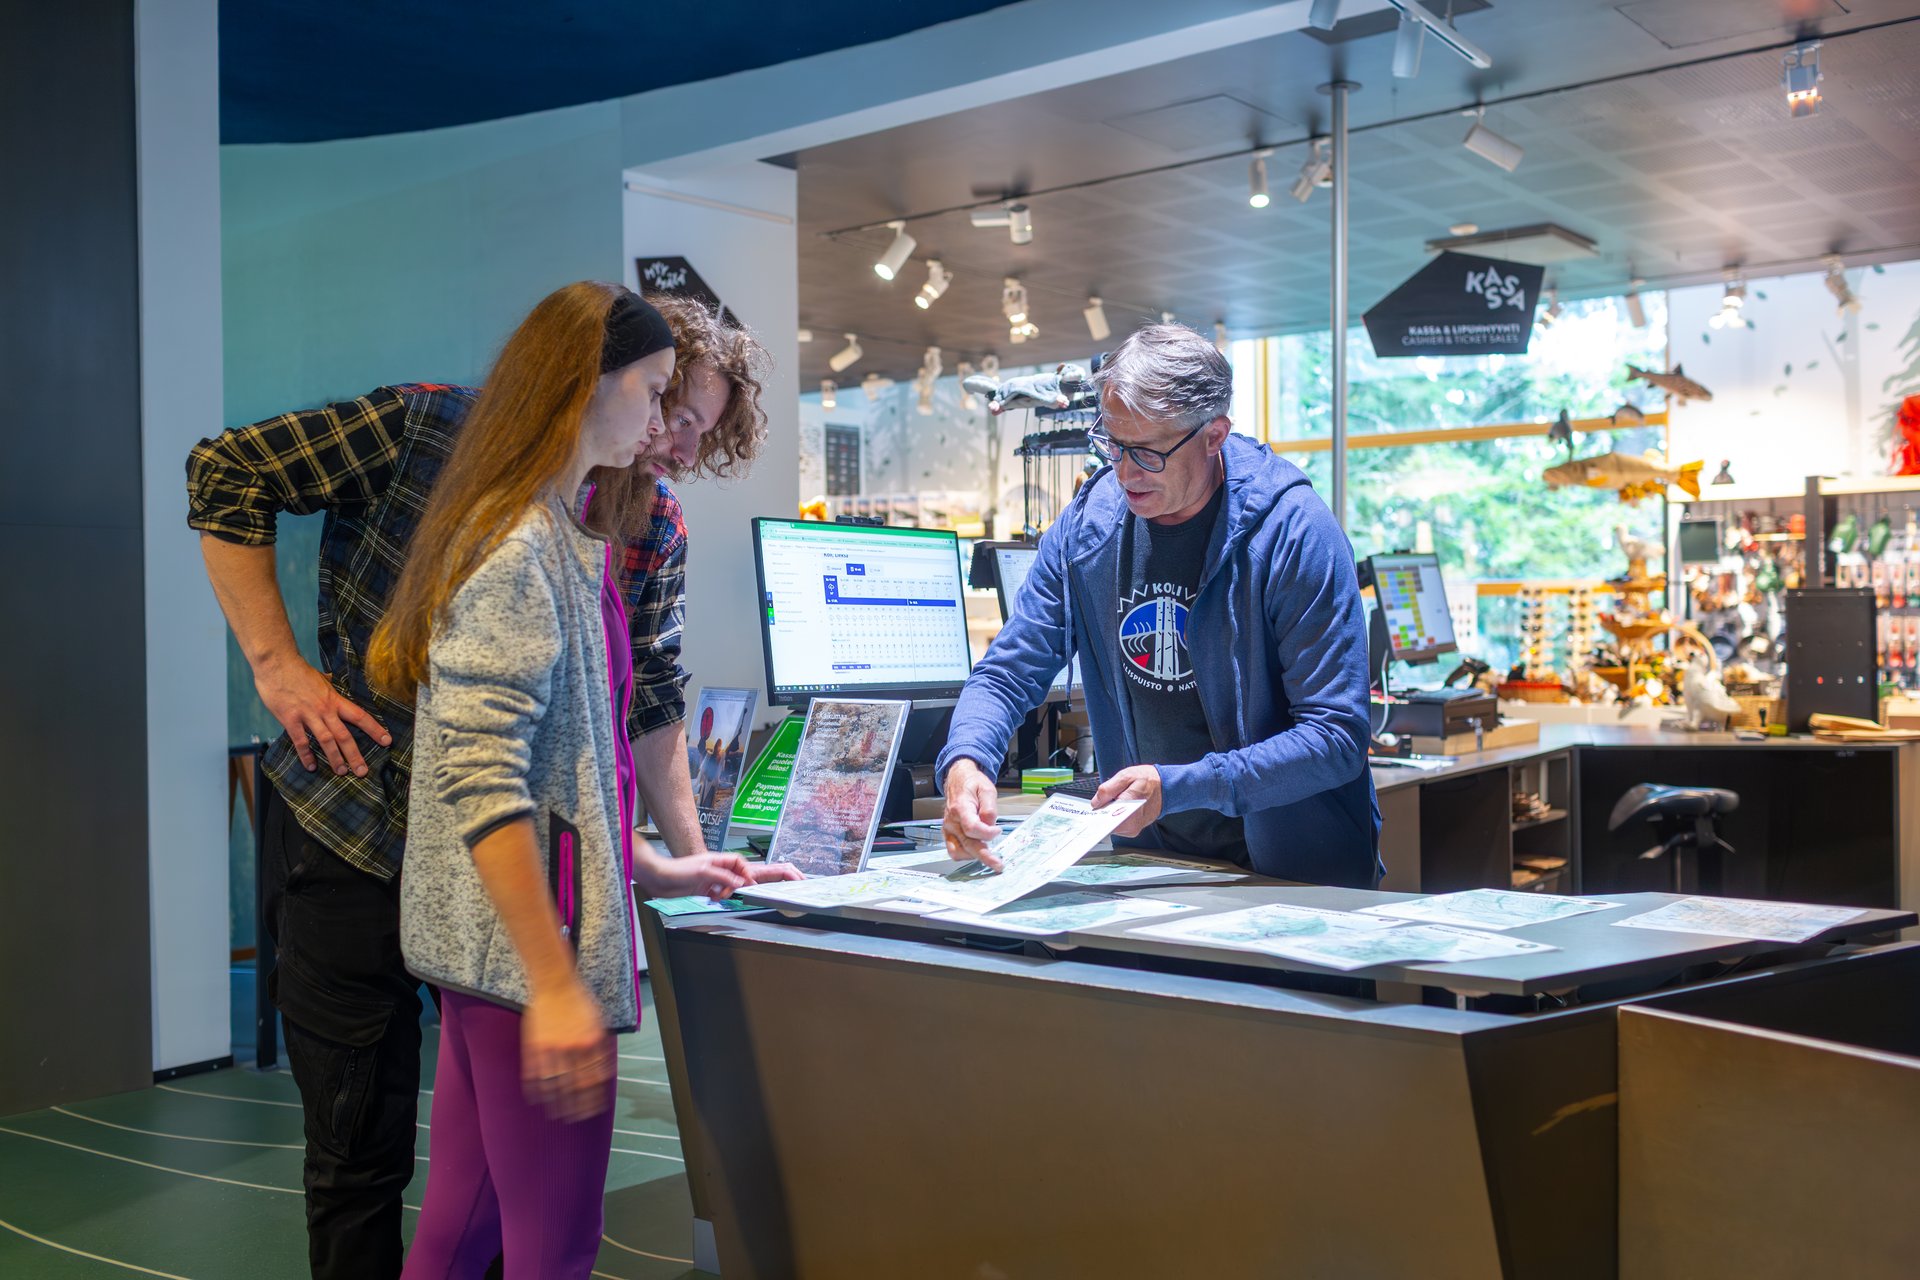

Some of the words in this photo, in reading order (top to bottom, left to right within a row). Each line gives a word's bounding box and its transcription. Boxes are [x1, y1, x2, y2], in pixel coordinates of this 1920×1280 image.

[1408, 325, 1441, 336] KASSA
[1442, 324, 1451, 335] &
[1401, 335, 1443, 346] CASHIER
[1454, 334, 1487, 345] TICKET
[1489, 333, 1519, 344] SALES
[1152, 582, 1182, 597] KOLI
[761, 804, 779, 812] you!
